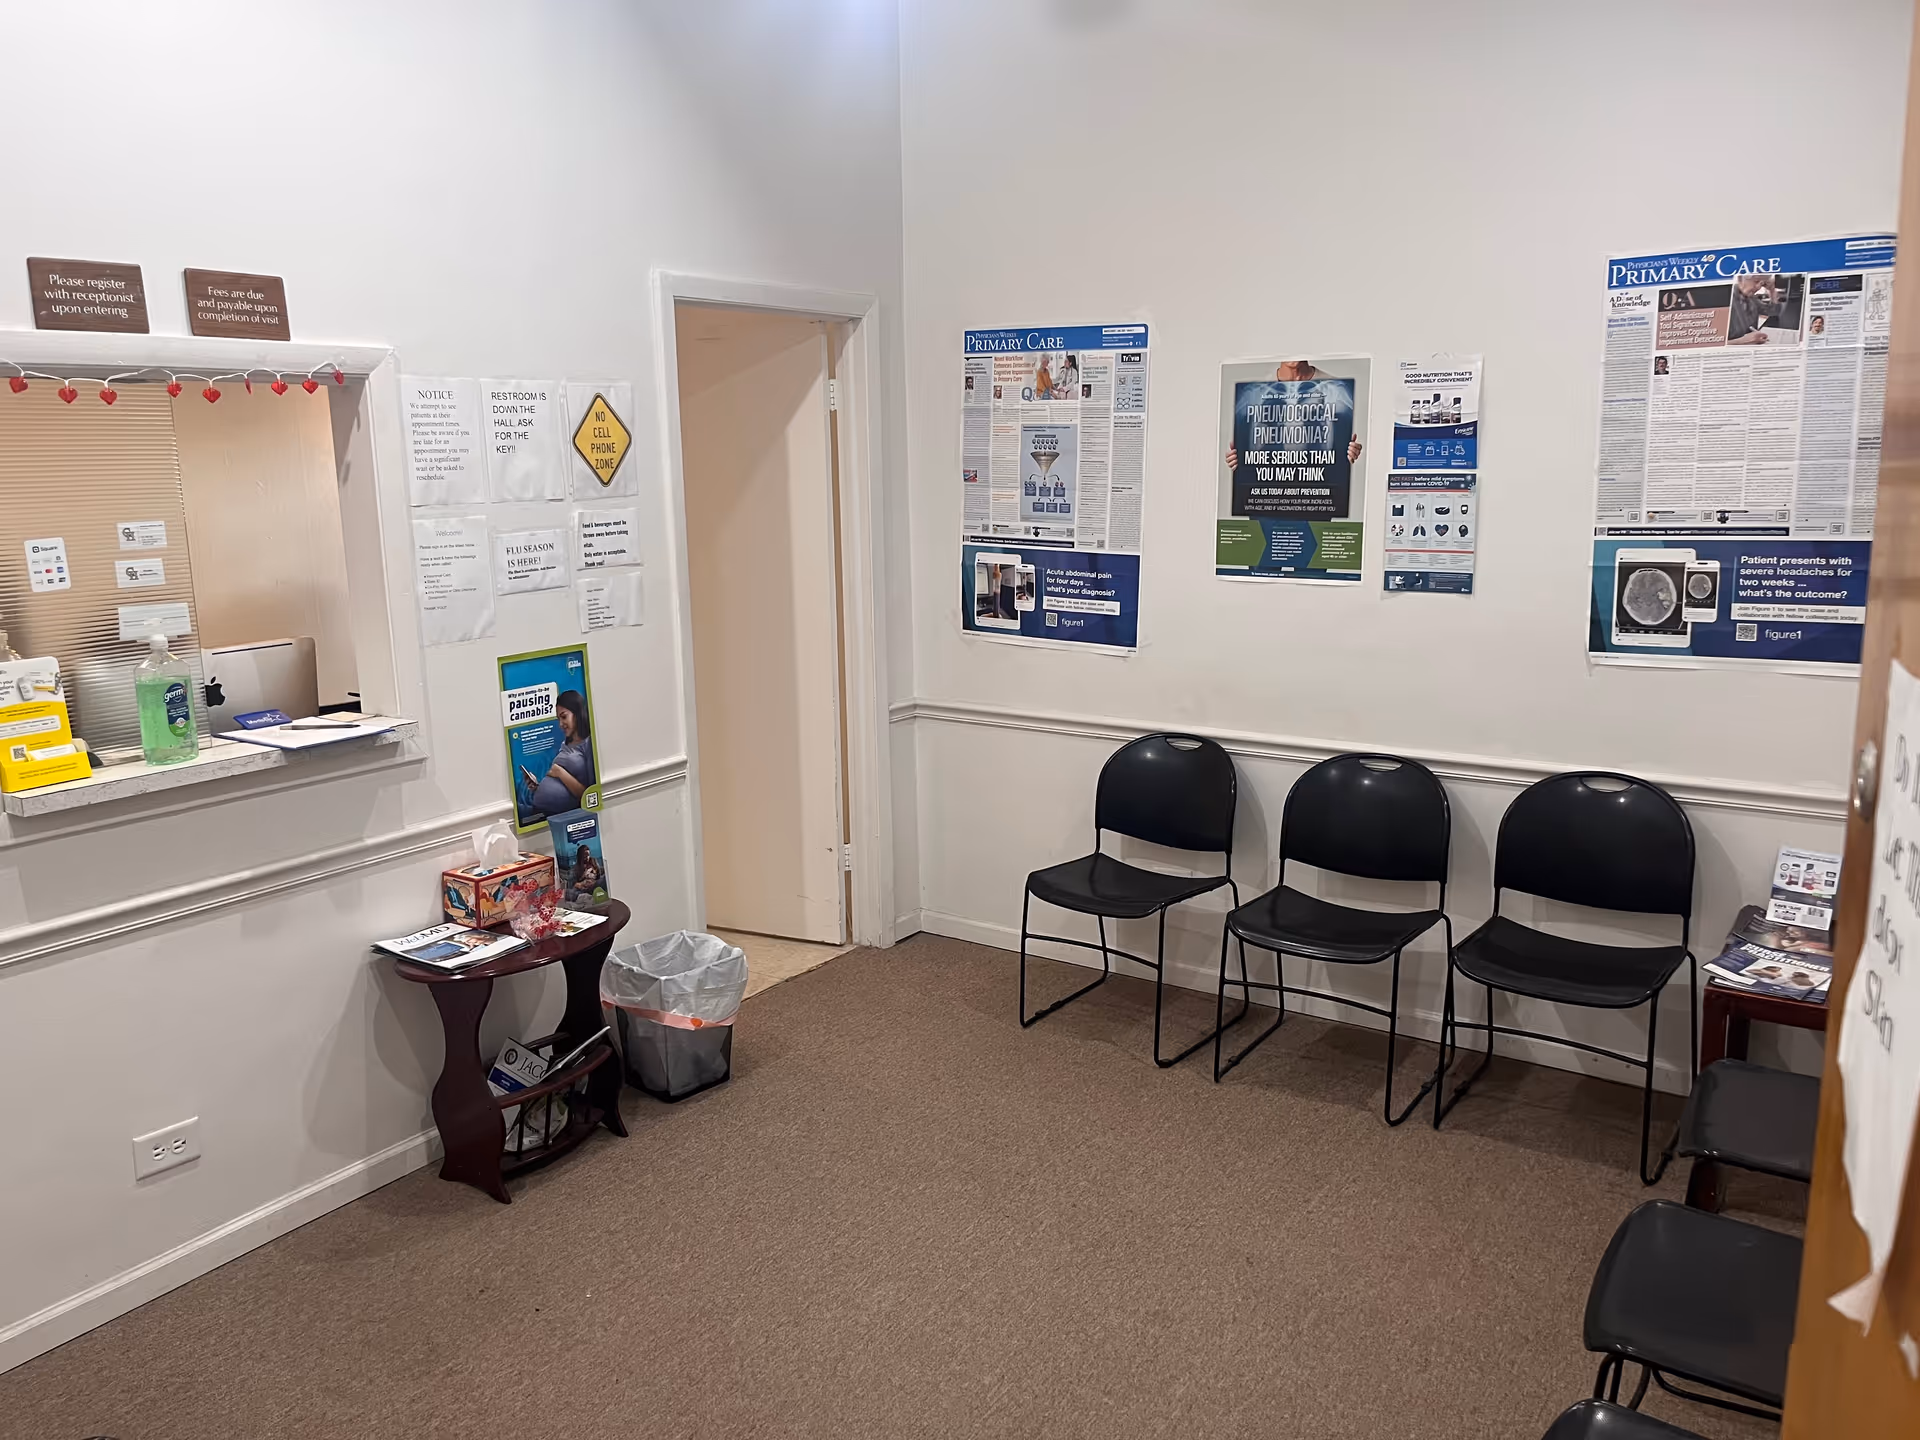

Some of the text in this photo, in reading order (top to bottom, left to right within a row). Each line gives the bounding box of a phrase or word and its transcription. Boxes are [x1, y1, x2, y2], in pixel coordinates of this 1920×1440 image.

[1610, 254, 1781, 286] PRIMARY CARE
[49, 274, 126, 290] Please register
[44, 288, 135, 304] with receptionist
[208, 286, 264, 300] Fees are due
[197, 298, 278, 314] and payable upon
[1611, 300, 1651, 308] Knowledge
[52, 304, 128, 319] upon entering
[198, 310, 279, 325] completion of visit
[1688, 328, 1717, 337] Cognitive
[966, 332, 1064, 351] PRIMARY CARE
[417, 389, 454, 400] NOTICE
[491, 391, 547, 401] RESTROOM IS
[409, 402, 419, 410] We
[492, 405, 536, 414] DOWN THE
[595, 411, 606, 422] NO
[1247, 403, 1338, 423] PNEUMOCOCCAL
[517, 418, 534, 427] ASK
[495, 431, 529, 440] FOR THE
[593, 427, 611, 438] CELL
[1253, 425, 1329, 444] PNEUMONIA?
[591, 442, 616, 454] PHONE
[1244, 450, 1335, 464] MORE SERIOUS THAN
[595, 458, 614, 470] ZONE
[1256, 467, 1325, 482] YOU MAY THINK
[1300, 488, 1330, 496] PREVENTION
[506, 542, 554, 555] FLU SEASON
[507, 556, 541, 568] IS HERE!
[1741, 556, 1852, 566] Patient presents with
[1046, 568, 1064, 576] Acute
[1066, 569, 1096, 578] abdominal
[1740, 567, 1852, 577] severe headaches for
[1069, 579, 1083, 587] days
[1739, 578, 1795, 587] two weeks
[1081, 588, 1115, 597] diagnosis?
[1738, 589, 1848, 599] what's the outcome?
[1062, 617, 1084, 627] figure1
[1765, 629, 1802, 640] figure1
[509, 693, 550, 713] pausing
[510, 704, 554, 721] cannabis?
